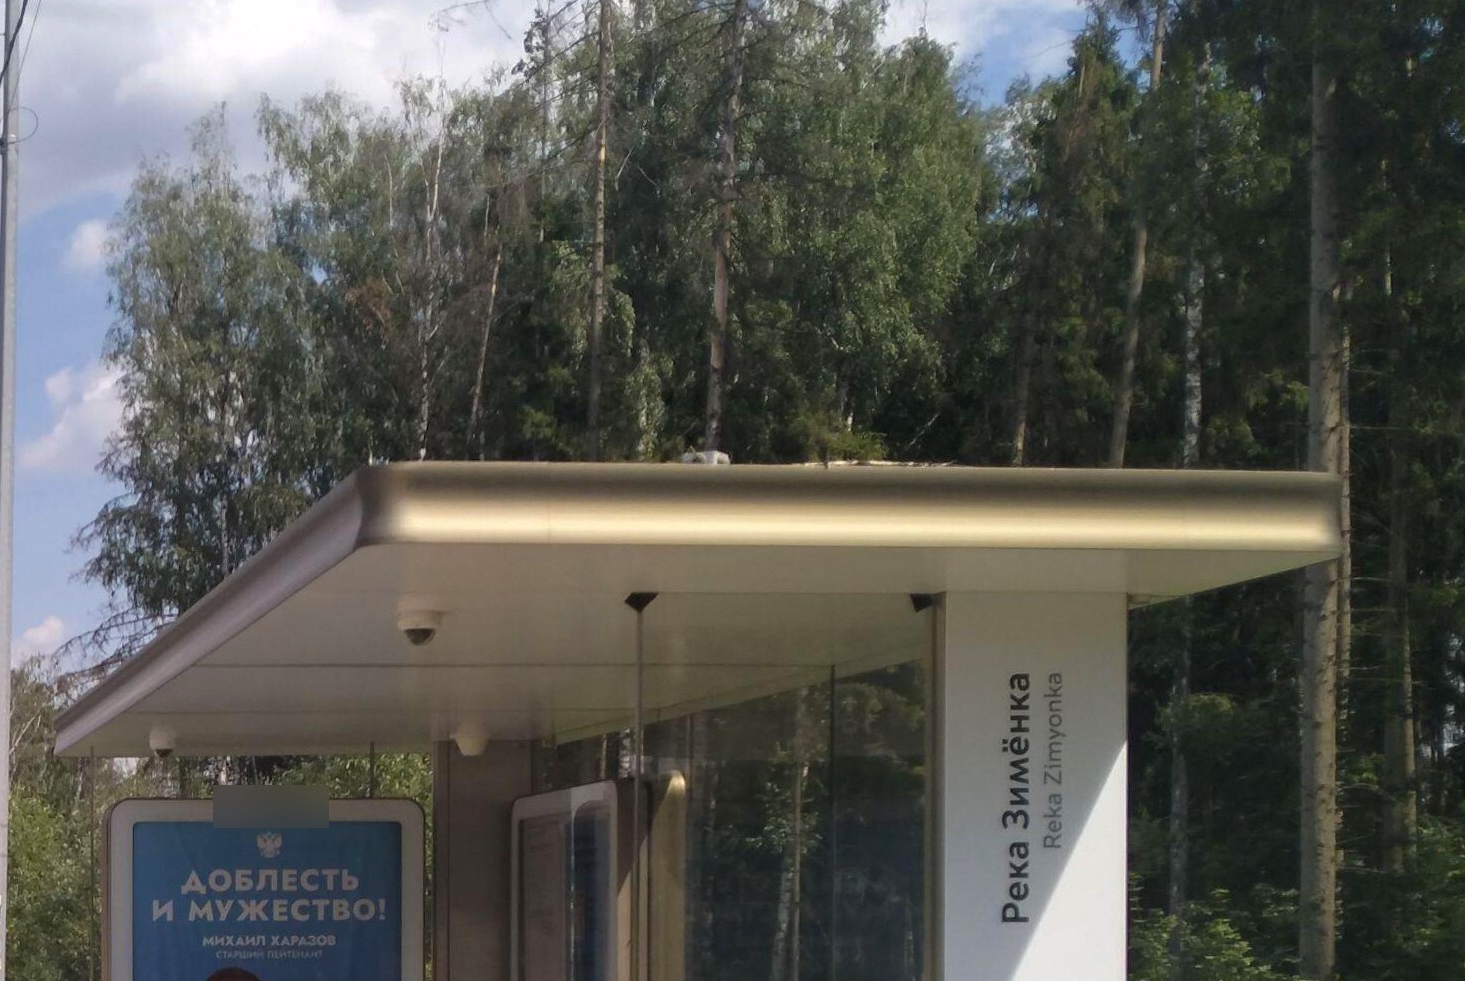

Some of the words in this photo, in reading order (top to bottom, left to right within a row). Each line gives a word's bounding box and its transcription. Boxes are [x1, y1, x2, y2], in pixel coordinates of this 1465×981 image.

[1001, 672, 1030, 829] Зимёнка
[1043, 672, 1066, 785] Zimyonka
[1043, 792, 1062, 849] Reka
[181, 868, 359, 895] ДОБЛЕСТЬ
[1001, 841, 1030, 923] Река
[152, 900, 174, 922] И
[188, 899, 387, 922] МУЖЕСТВО!
[202, 934, 266, 947] МИХАИЛ
[271, 934, 336, 947] ХАРАЗОВ
